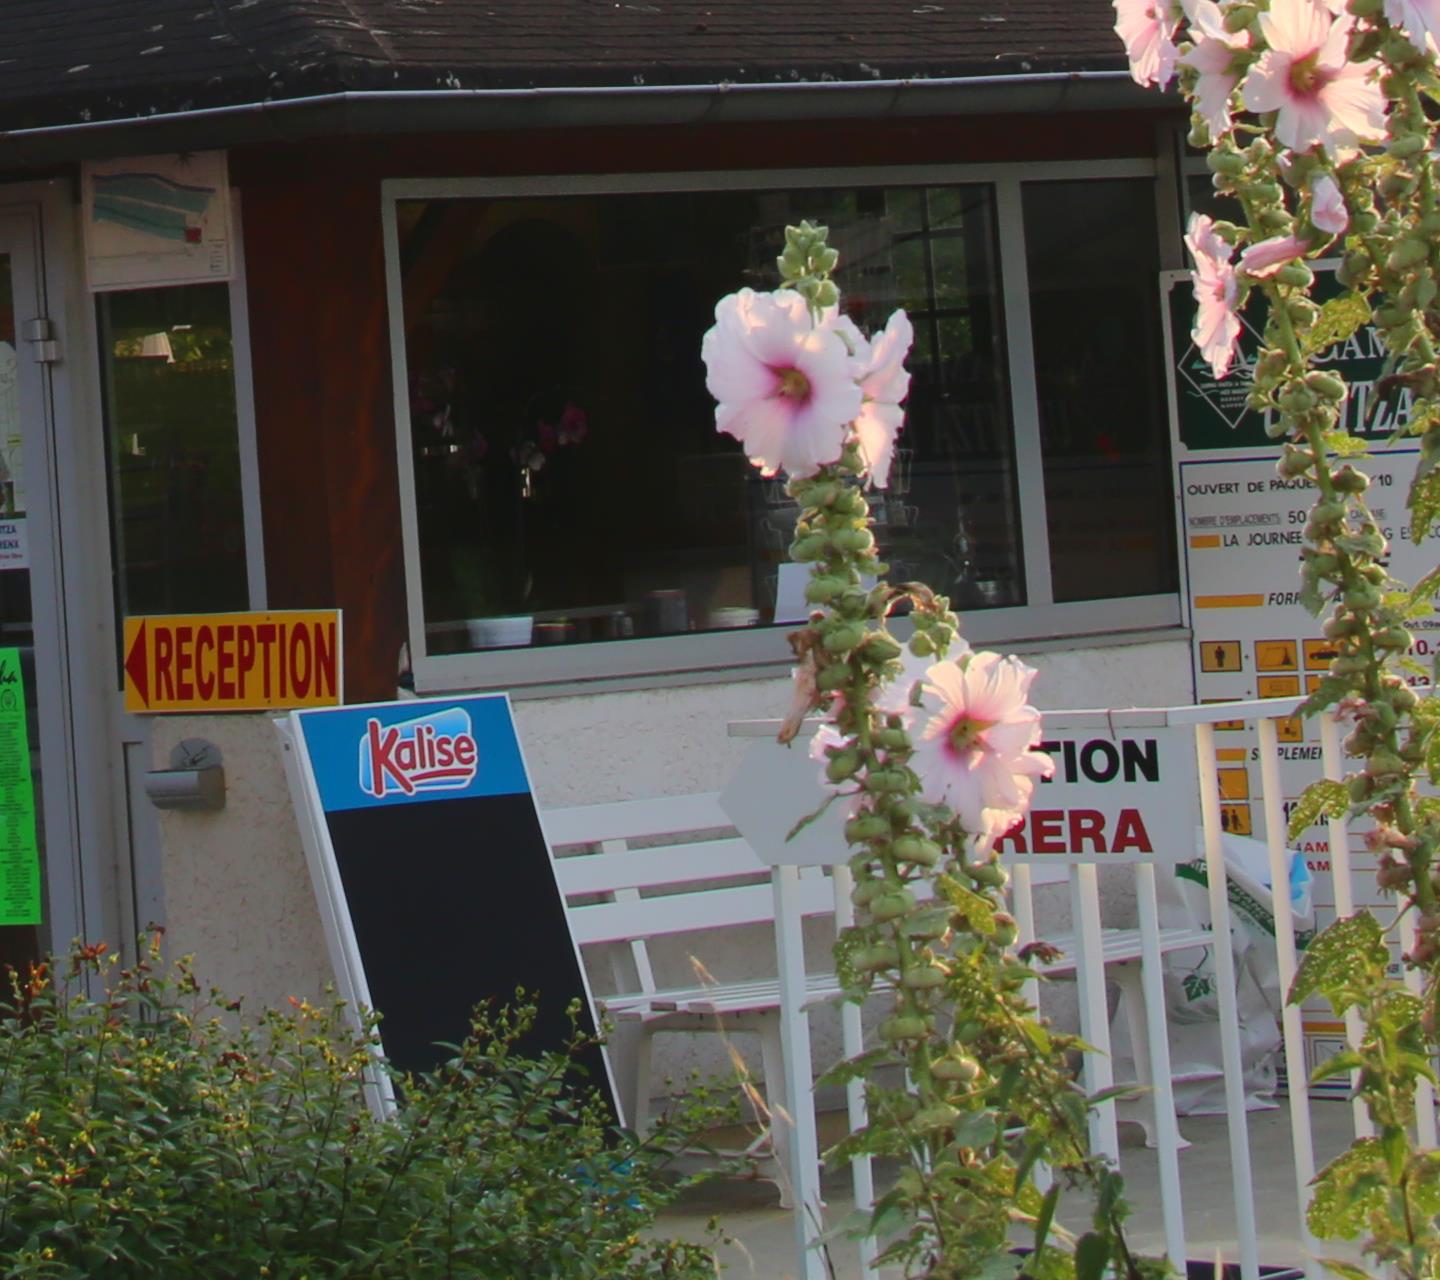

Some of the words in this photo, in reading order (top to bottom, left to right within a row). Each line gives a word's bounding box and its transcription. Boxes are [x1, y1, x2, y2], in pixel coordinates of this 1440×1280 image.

[1187, 482, 1240, 496] OUVERT
[1247, 480, 1265, 493] DE
[1288, 510, 1306, 523] 50
[1223, 534, 1239, 547] LA
[155, 621, 337, 702] RECEPTION
[367, 718, 477, 797] Kalise
[993, 808, 1154, 854] RERA
